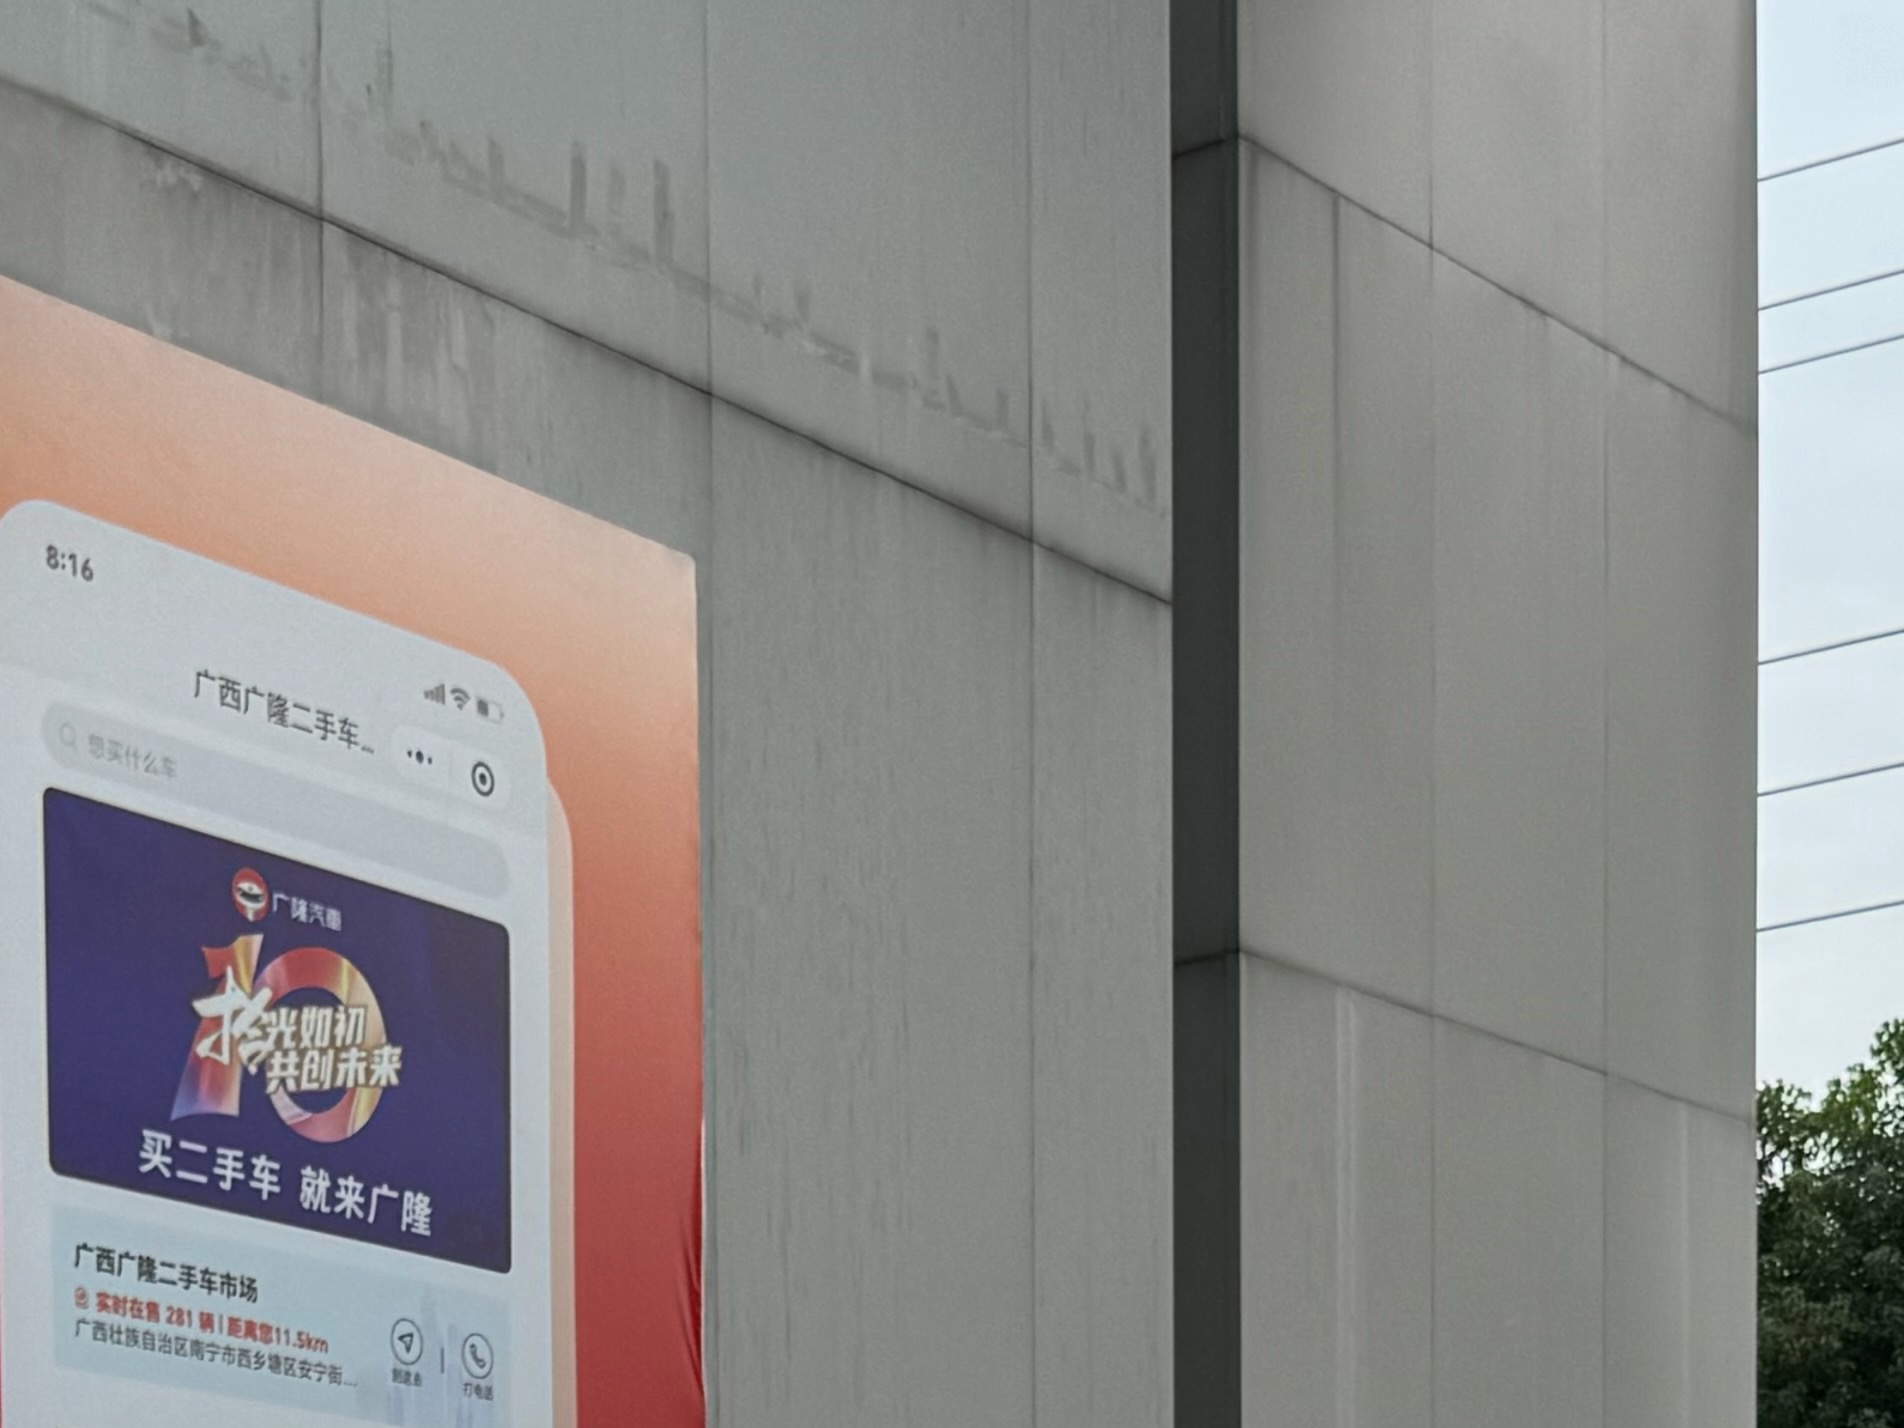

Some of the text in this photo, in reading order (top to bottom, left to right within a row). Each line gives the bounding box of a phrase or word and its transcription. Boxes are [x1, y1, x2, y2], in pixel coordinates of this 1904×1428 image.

[45, 544, 94, 582] 8:16
[88, 733, 178, 779] 想买什么车
[266, 1045, 402, 1094] 共创未来
[138, 1128, 433, 1237] 买二手车 就来广隆
[74, 1242, 259, 1304] 广西广隆二手车市场
[166, 1305, 193, 1328] 281
